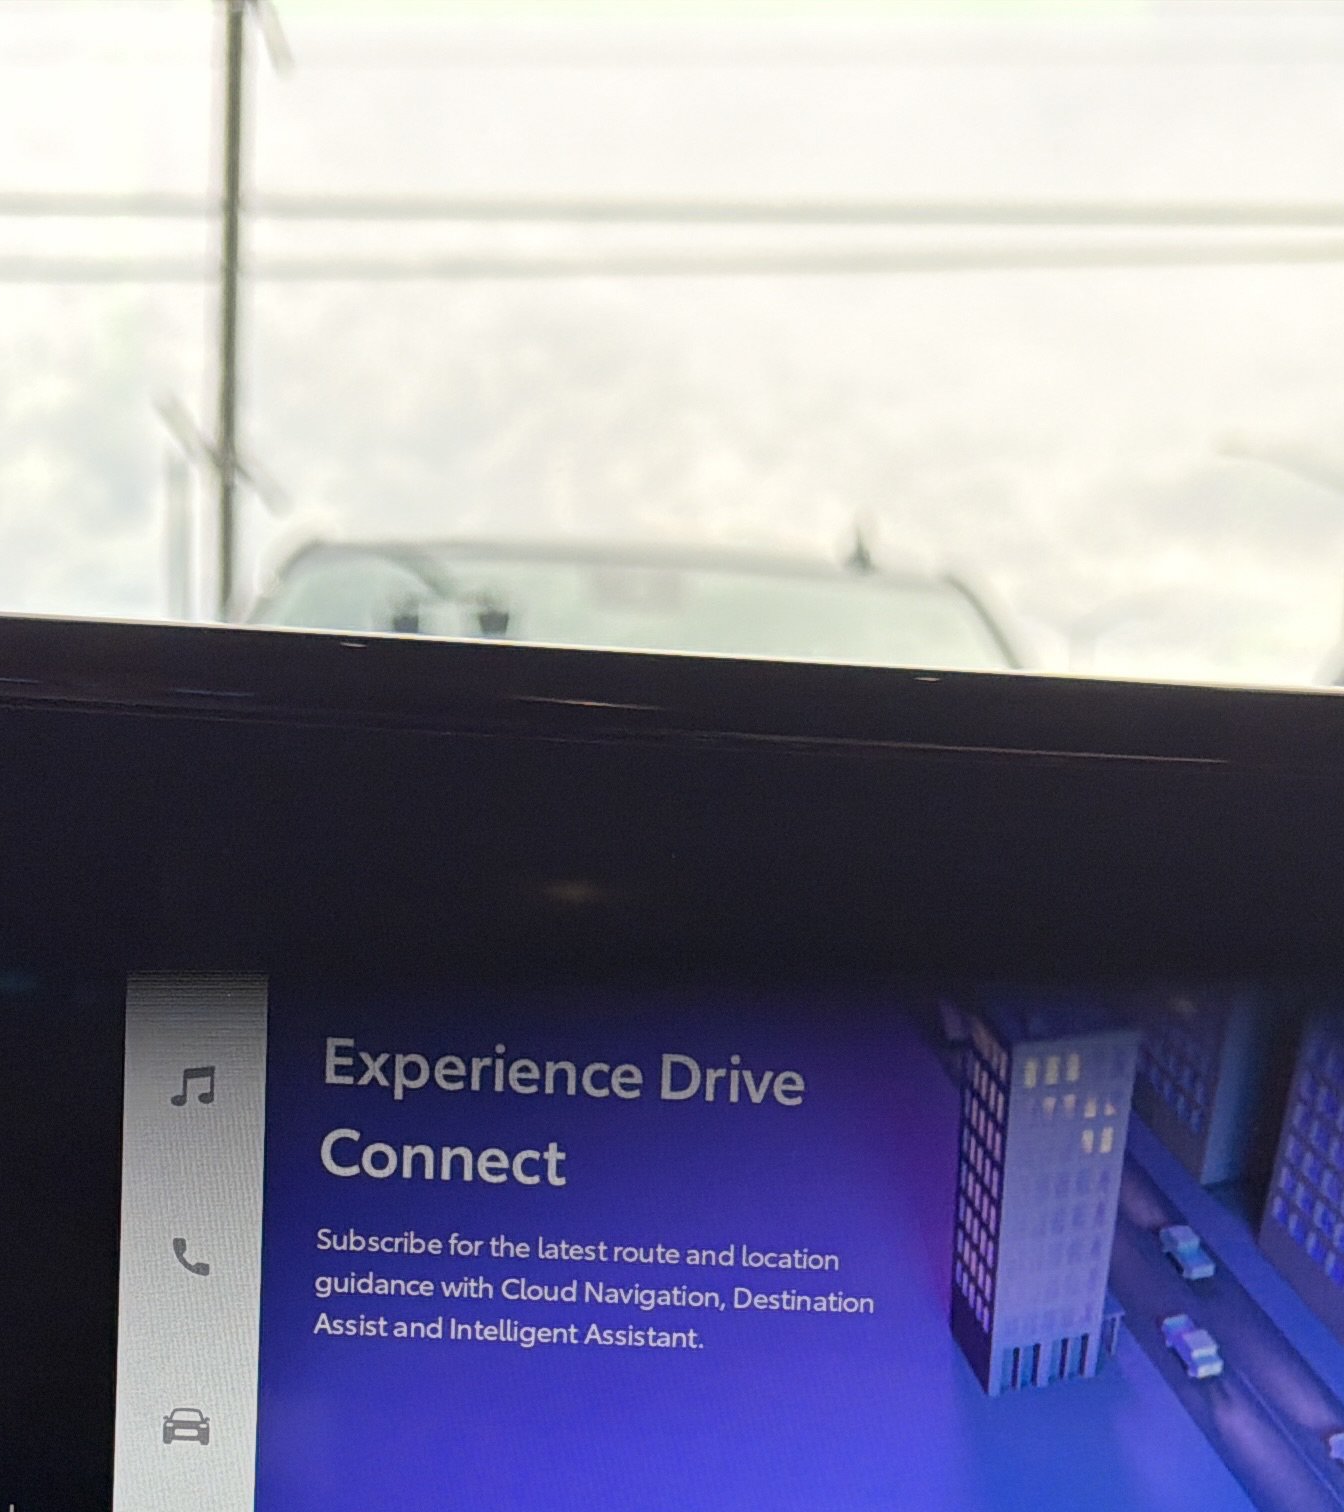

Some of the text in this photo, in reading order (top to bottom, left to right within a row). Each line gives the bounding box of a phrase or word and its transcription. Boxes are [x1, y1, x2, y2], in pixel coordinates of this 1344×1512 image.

[323, 1036, 806, 1106] Experience Drive
[320, 1128, 567, 1187] Connect
[316, 1228, 840, 1271] Subscribe for the latest route and location
[314, 1272, 875, 1314] guidance with Cloud Navigation, Destination
[313, 1312, 704, 1349] Assist and Intelligent Assistant.
